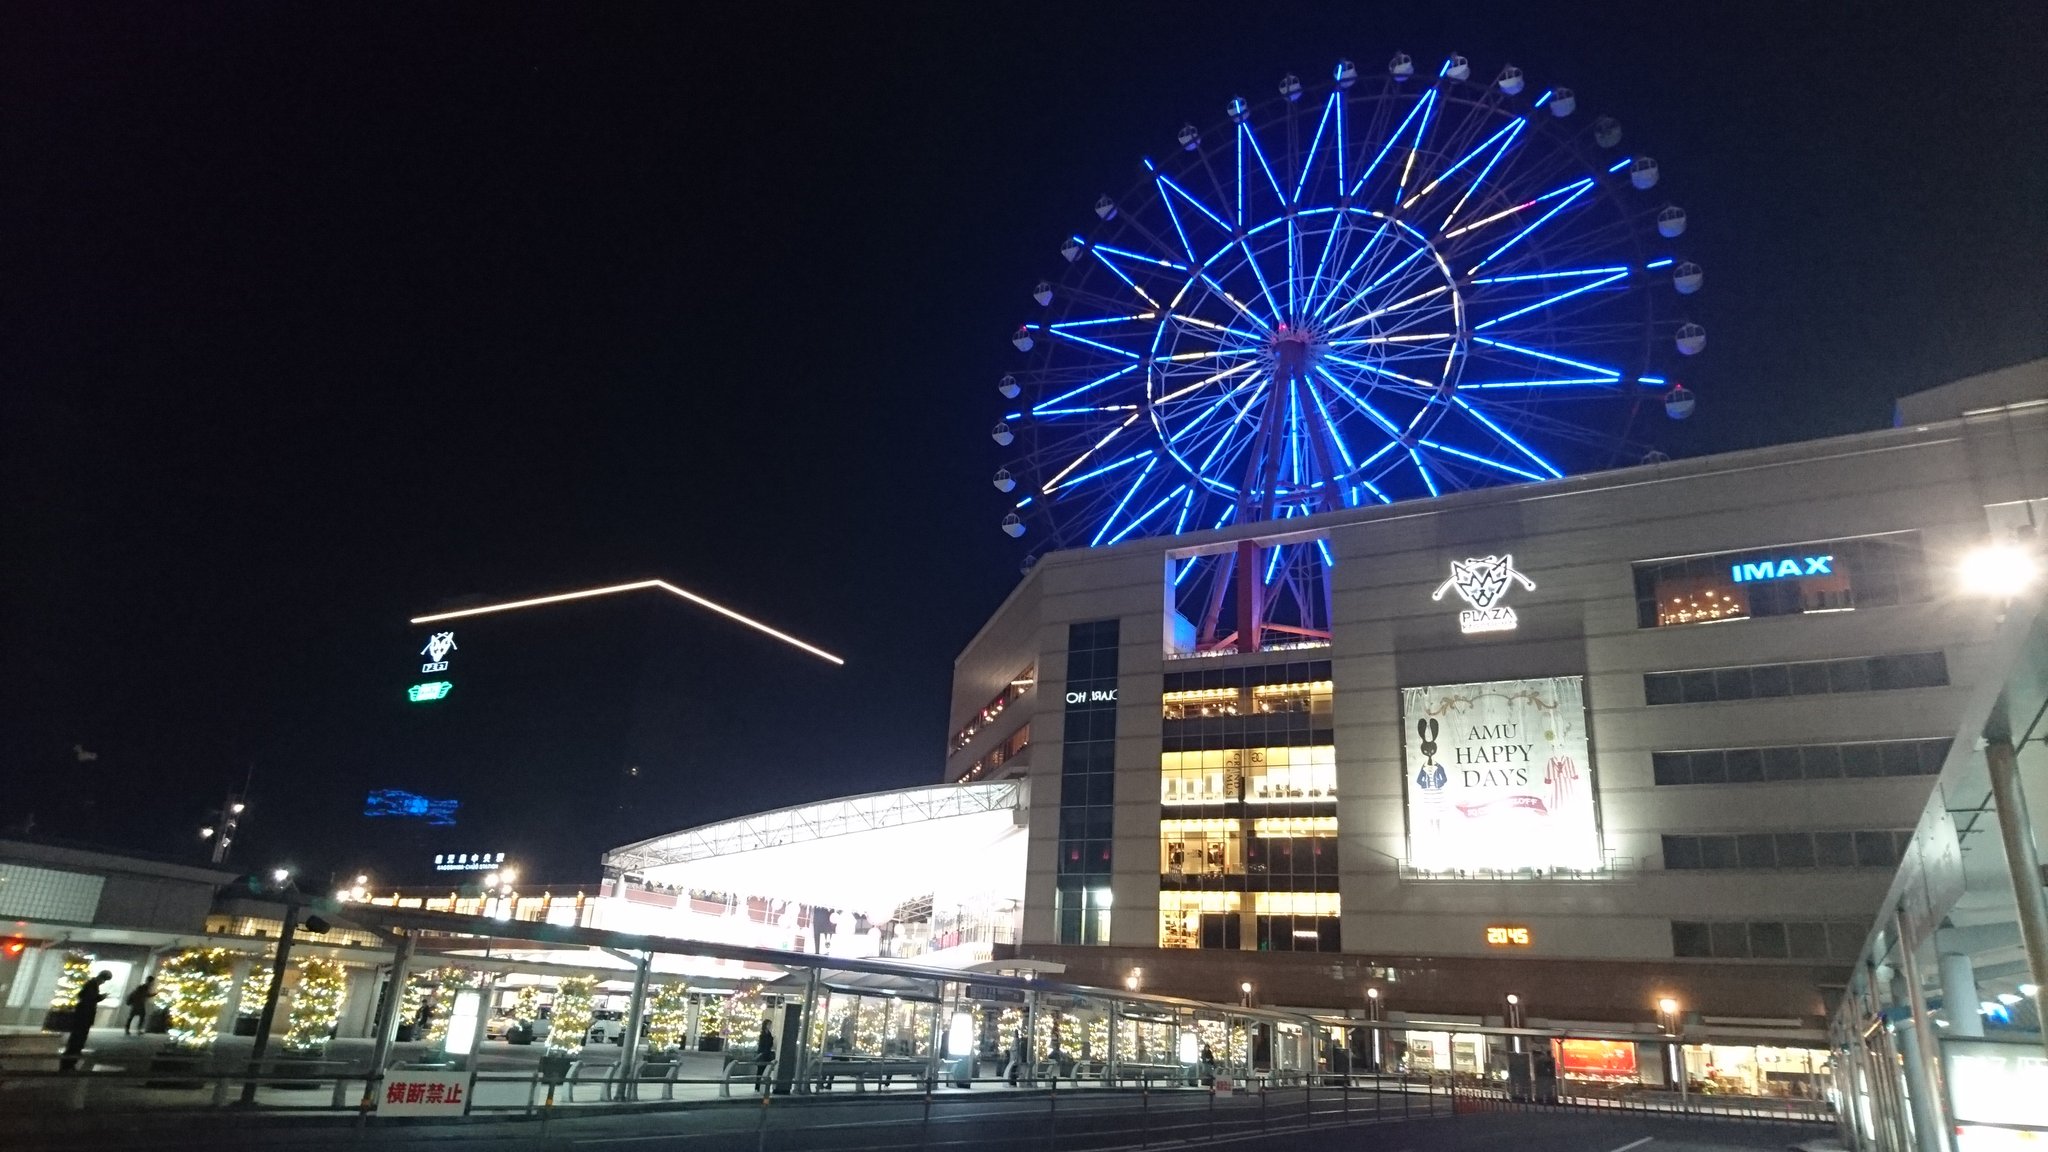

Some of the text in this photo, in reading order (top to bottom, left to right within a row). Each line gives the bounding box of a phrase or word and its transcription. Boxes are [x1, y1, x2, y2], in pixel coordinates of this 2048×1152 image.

[1732, 556, 1831, 582] IMAX
[1462, 608, 1513, 622] PLAZA
[1468, 723, 1518, 740] AMU
[1455, 744, 1534, 764] HAPPY
[1461, 768, 1528, 788] DAYS
[387, 1082, 463, 1105] 横断禁止
